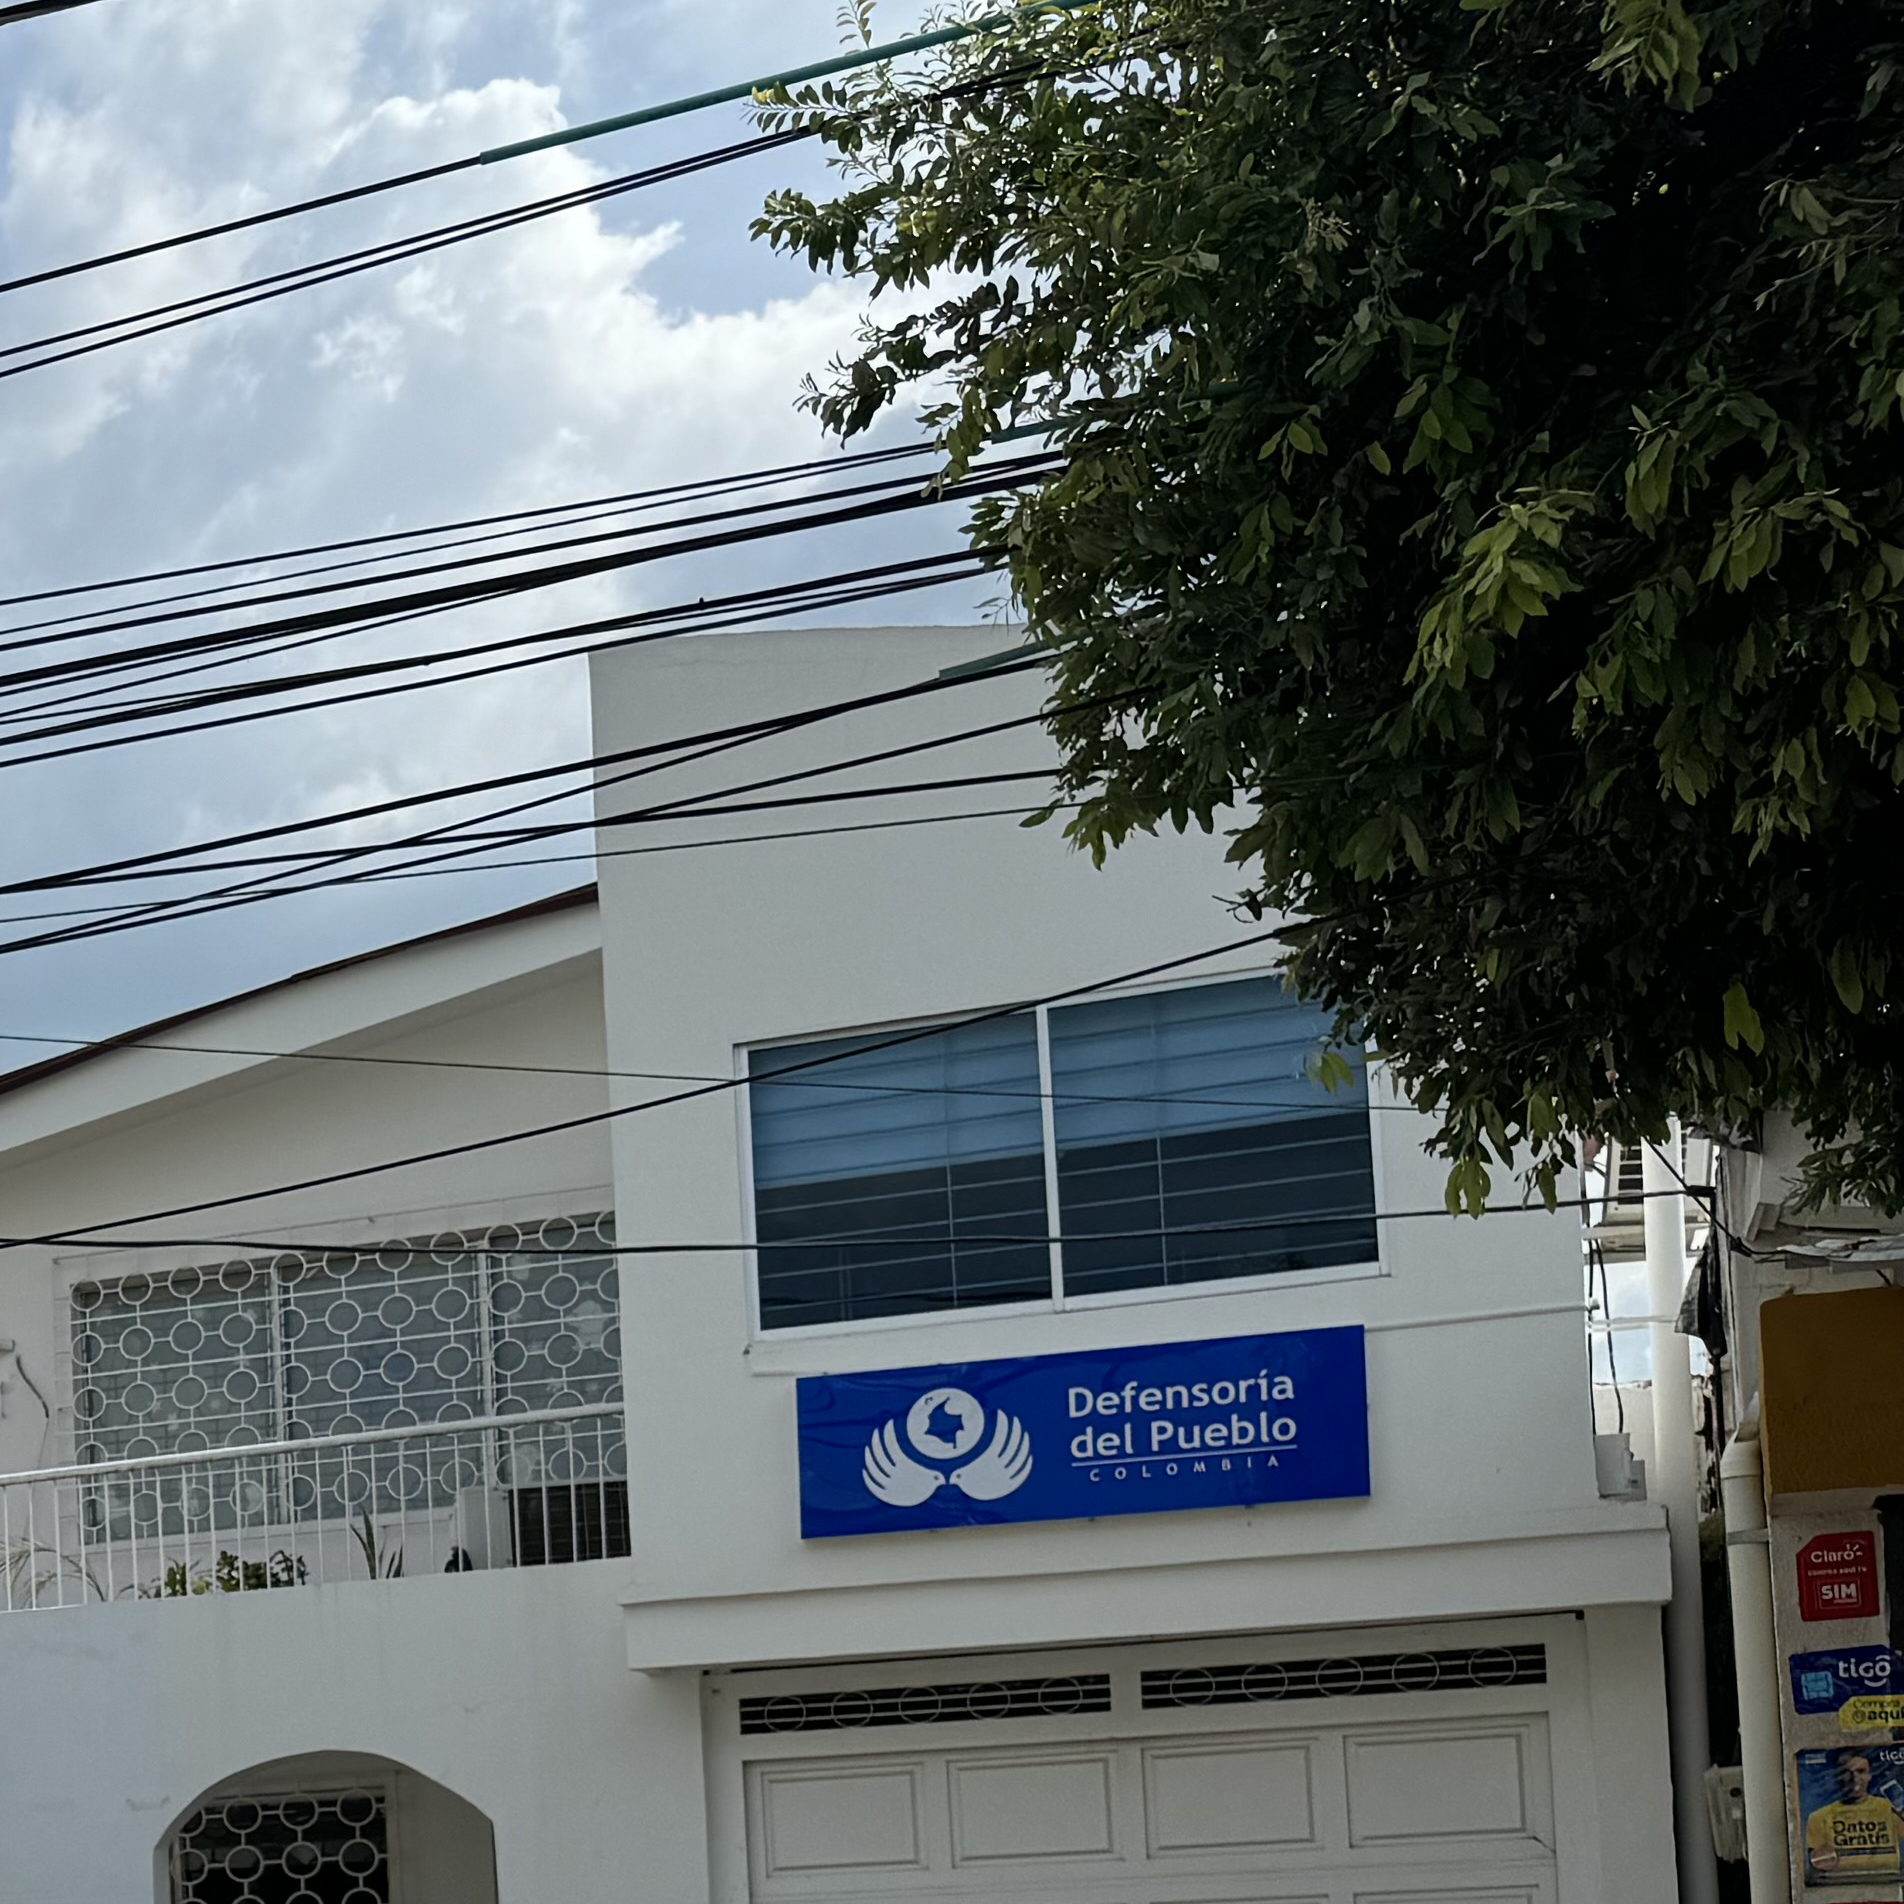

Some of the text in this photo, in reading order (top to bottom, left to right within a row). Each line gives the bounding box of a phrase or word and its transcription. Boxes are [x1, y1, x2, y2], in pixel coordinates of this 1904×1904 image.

[1067, 1368, 1295, 1418] Defensoría
[1070, 1411, 1298, 1460] del Pueblo
[1089, 1454, 1280, 1482] COLOMBIA
[1810, 1546, 1858, 1564] Claro
[1821, 1582, 1857, 1601] SIM
[1832, 1820, 1887, 1835] Datos
